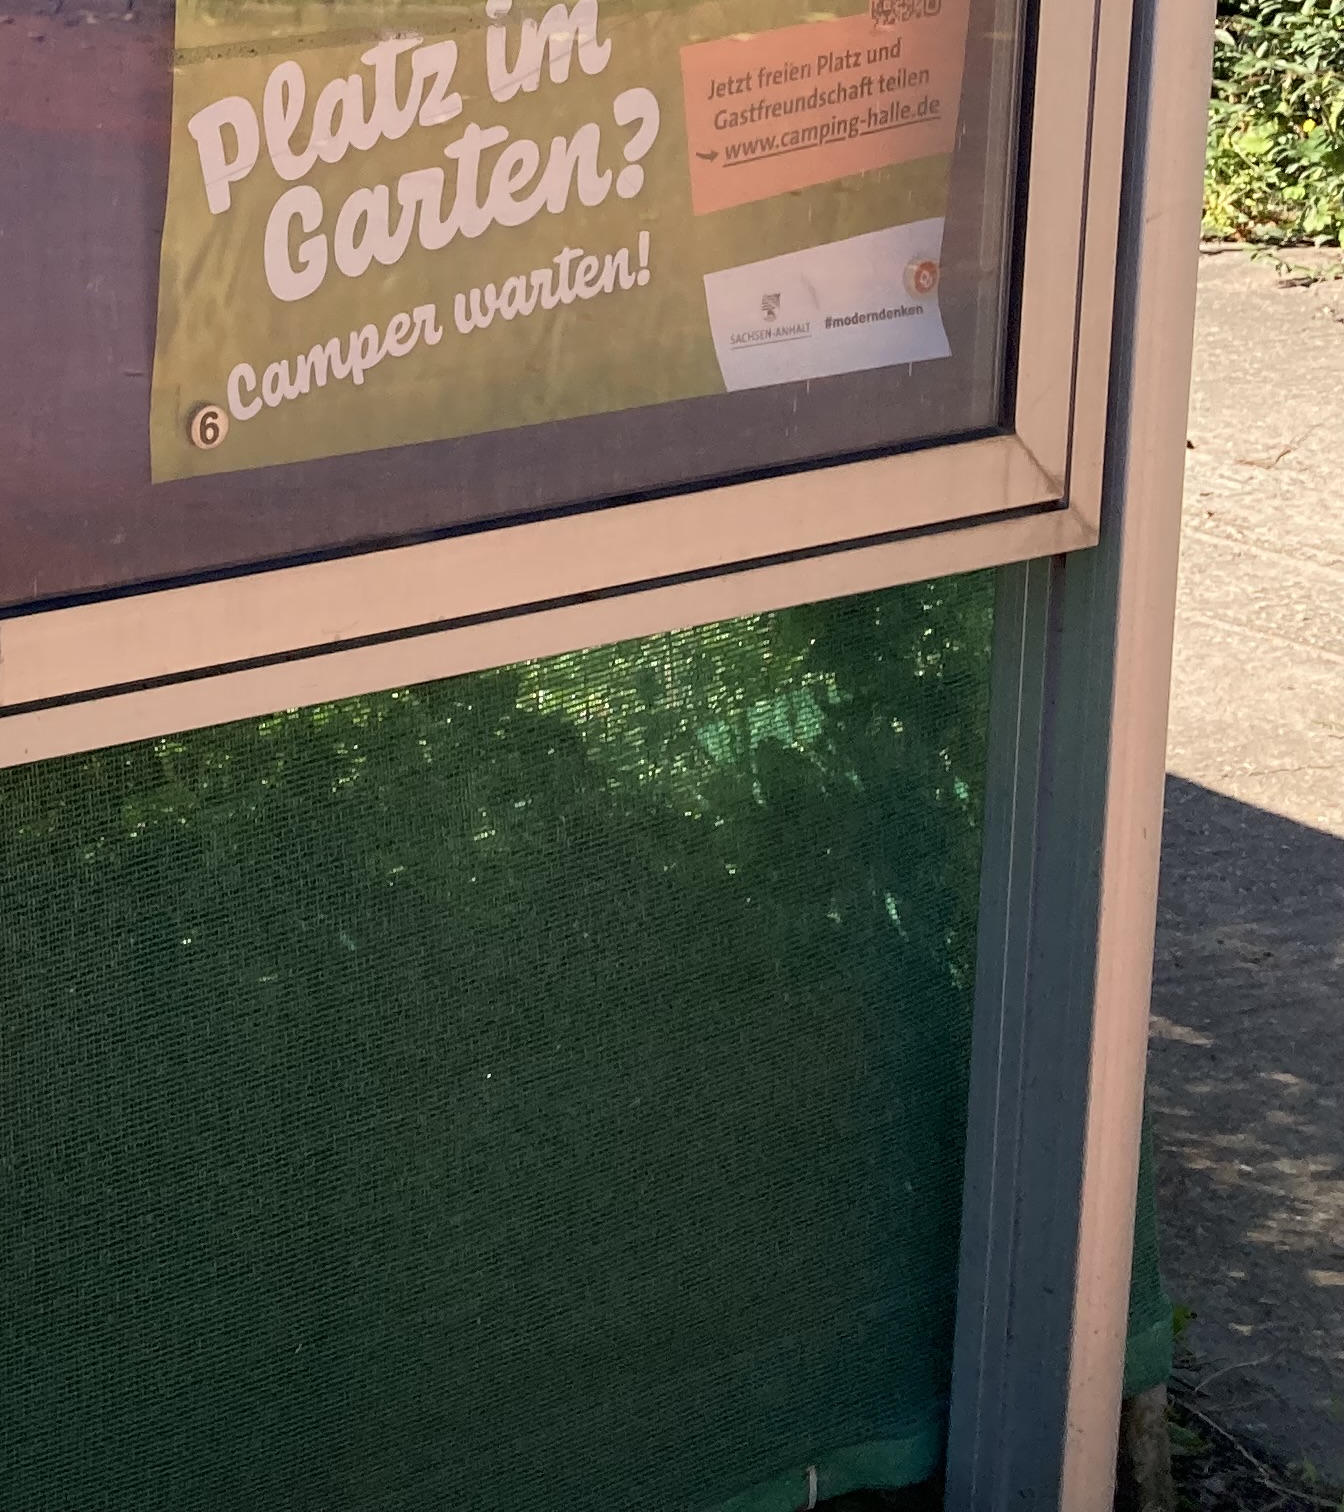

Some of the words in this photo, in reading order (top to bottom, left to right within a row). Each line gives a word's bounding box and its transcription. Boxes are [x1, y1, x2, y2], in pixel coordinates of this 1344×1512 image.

[708, 74, 752, 101] Jetzt
[757, 61, 812, 90] freien
[817, 49, 862, 77] Platz
[867, 37, 902, 64] und
[713, 76, 874, 131] Gastfreundschaft
[878, 67, 930, 95] teilen
[188, 36, 463, 214] Platz
[724, 95, 940, 160] www.camping-halle.de
[263, 87, 661, 302] Garten?
[227, 303, 444, 421] Camper
[454, 230, 651, 335] warten!
[729, 321, 811, 345] SACHSEN-ANHALT
[824, 304, 924, 330] #moderndenken
[198, 410, 220, 445] 6
